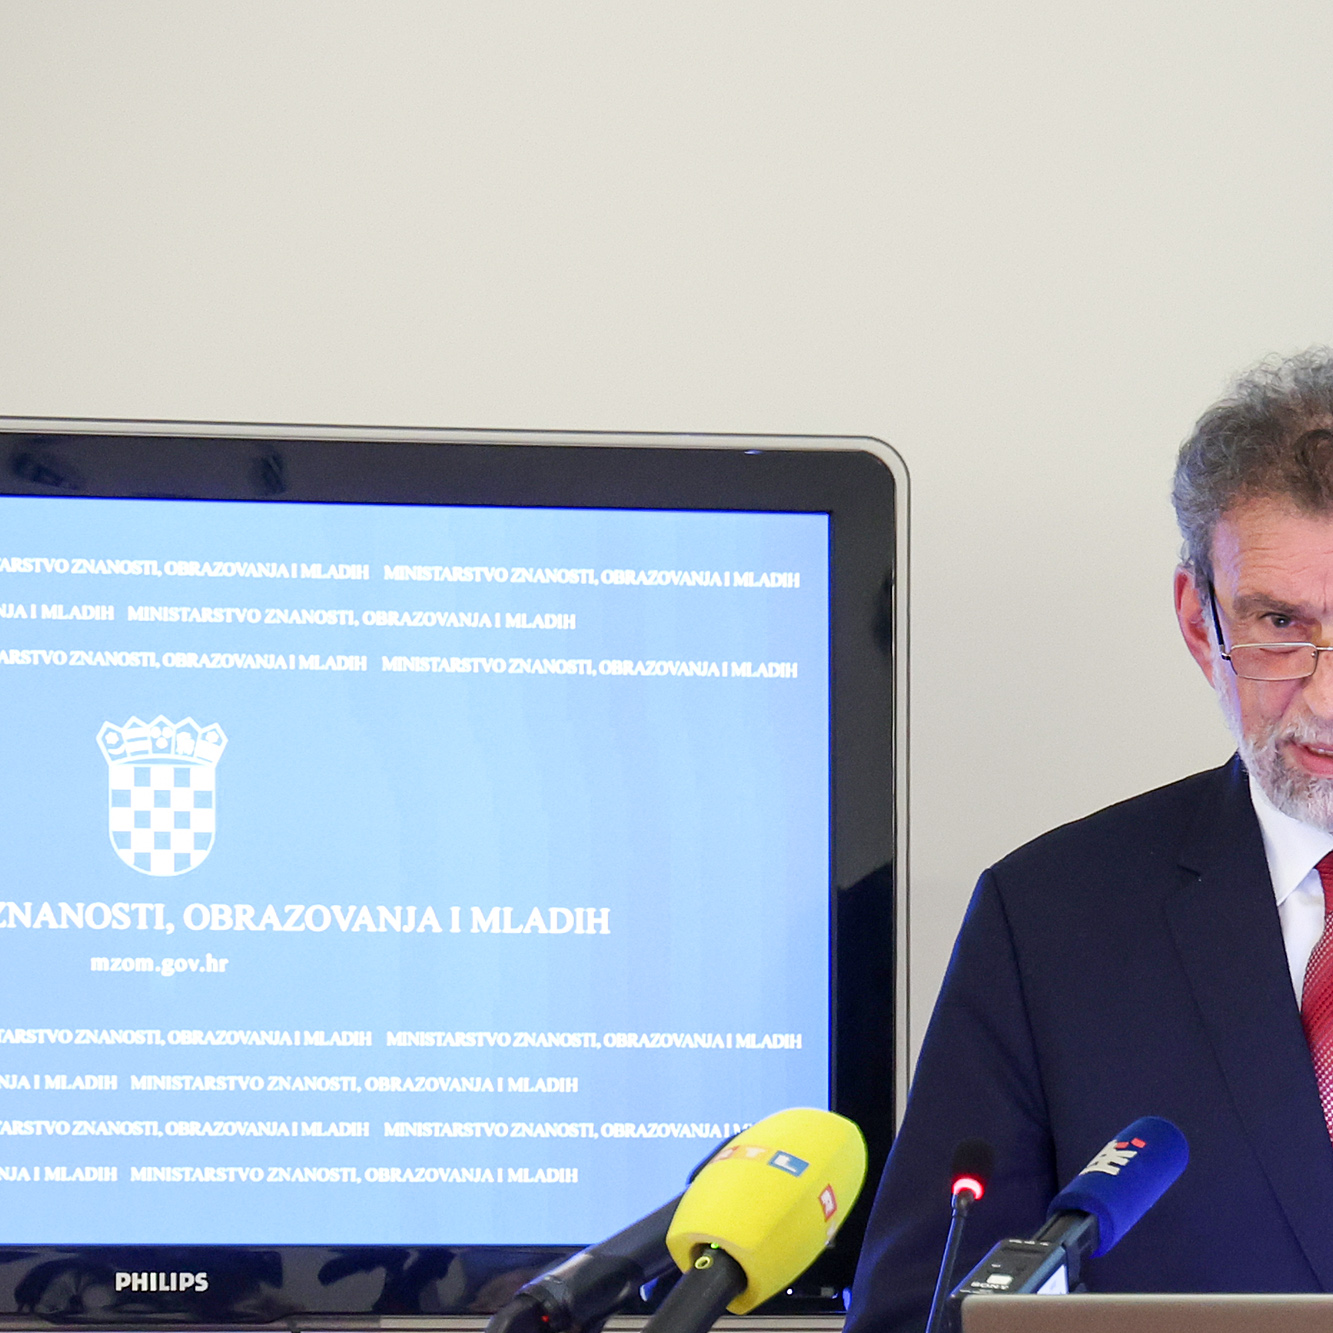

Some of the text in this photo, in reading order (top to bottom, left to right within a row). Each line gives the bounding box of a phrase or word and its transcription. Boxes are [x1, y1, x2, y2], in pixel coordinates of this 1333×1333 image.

[71, 558, 163, 577] ZNANOSTI,
[163, 560, 290, 579] OBRAZOVANJA
[291, 562, 298, 579] I
[300, 563, 370, 580] MLADIH
[383, 564, 800, 588] MINISTARSTVO ZNANOSTI, OBRAZOVANJA I MLADIH
[30, 603, 37, 619] I
[41, 604, 115, 621] MLADIH
[127, 605, 576, 630] MINISTARSTVO ZNANOSTI, OBRAZOVANJA I MLADIH
[69, 650, 161, 669] ZNANOSTI,
[161, 652, 288, 670] OBRAZOVANJA
[288, 654, 296, 670] I
[298, 654, 368, 672] MLADIH
[381, 655, 798, 678] MINISTARSTVO ZNANOSTI, OBRAZOVANJA I MLADIH
[182, 903, 442, 933] OBRAZOVANJA
[450, 906, 461, 934] I
[470, 906, 611, 935] MLADIH
[90, 953, 229, 977] mzom.gov.hr
[74, 1029, 166, 1046] ZNANOSTI,
[167, 1029, 293, 1046] OBRAZOVANJA
[294, 1030, 301, 1046] I
[303, 1030, 372, 1047] MLADIH
[386, 1031, 802, 1049] MINISTARSTVO ZNANOSTI, OBRAZOVANJA I MLADIH
[33, 1074, 40, 1090] I
[44, 1074, 118, 1090] MLADIH
[130, 1074, 579, 1093] MINISTARSTVO ZNANOSTI, OBRAZOVANJA I MLADIH
[72, 1120, 163, 1137] ZNANOSTI,
[164, 1121, 290, 1137] OBRAZOVANJA
[291, 1121, 298, 1137] I
[301, 1121, 370, 1137] MLADIH
[384, 1121, 509, 1138] MINISTARSTVO
[510, 1122, 599, 1139] ZNANOSTI,
[600, 1122, 722, 1139] OBRAZOVANJA
[724, 1123, 731, 1138] I
[33, 1166, 40, 1182] I
[44, 1166, 118, 1182] MLADIH
[130, 1166, 578, 1184] MINISTARSTVO ZNANOSTI, OBRAZOVANJA I MLADIH
[115, 1272, 209, 1292] PHILIPS
